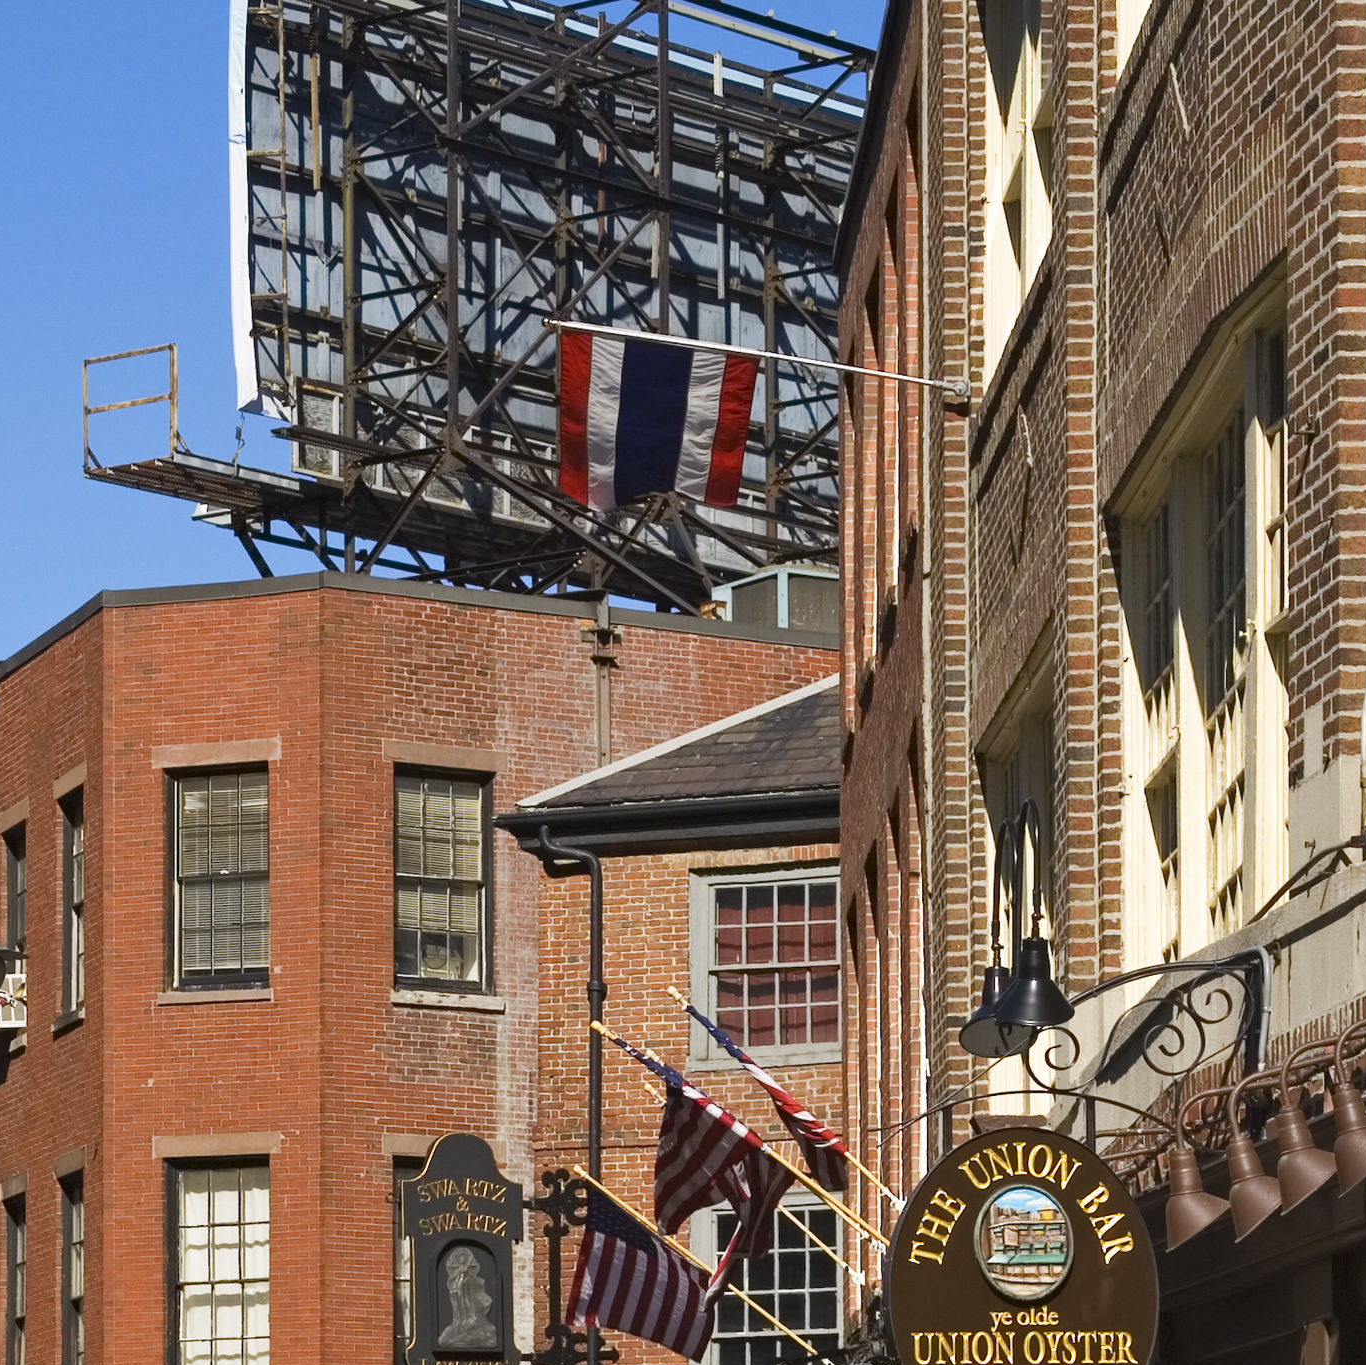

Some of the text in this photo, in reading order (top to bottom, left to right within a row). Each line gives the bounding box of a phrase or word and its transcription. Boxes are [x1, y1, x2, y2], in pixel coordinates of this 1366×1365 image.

[417, 1177, 507, 1203] SWARTZ
[456, 1196, 469, 1212] &
[908, 1141, 1134, 1266] THE UNION BAR
[419, 1213, 507, 1237] SWARTZ
[990, 1306, 1059, 1332] ye olde
[911, 1331, 1138, 1365] UNION OYSTER
